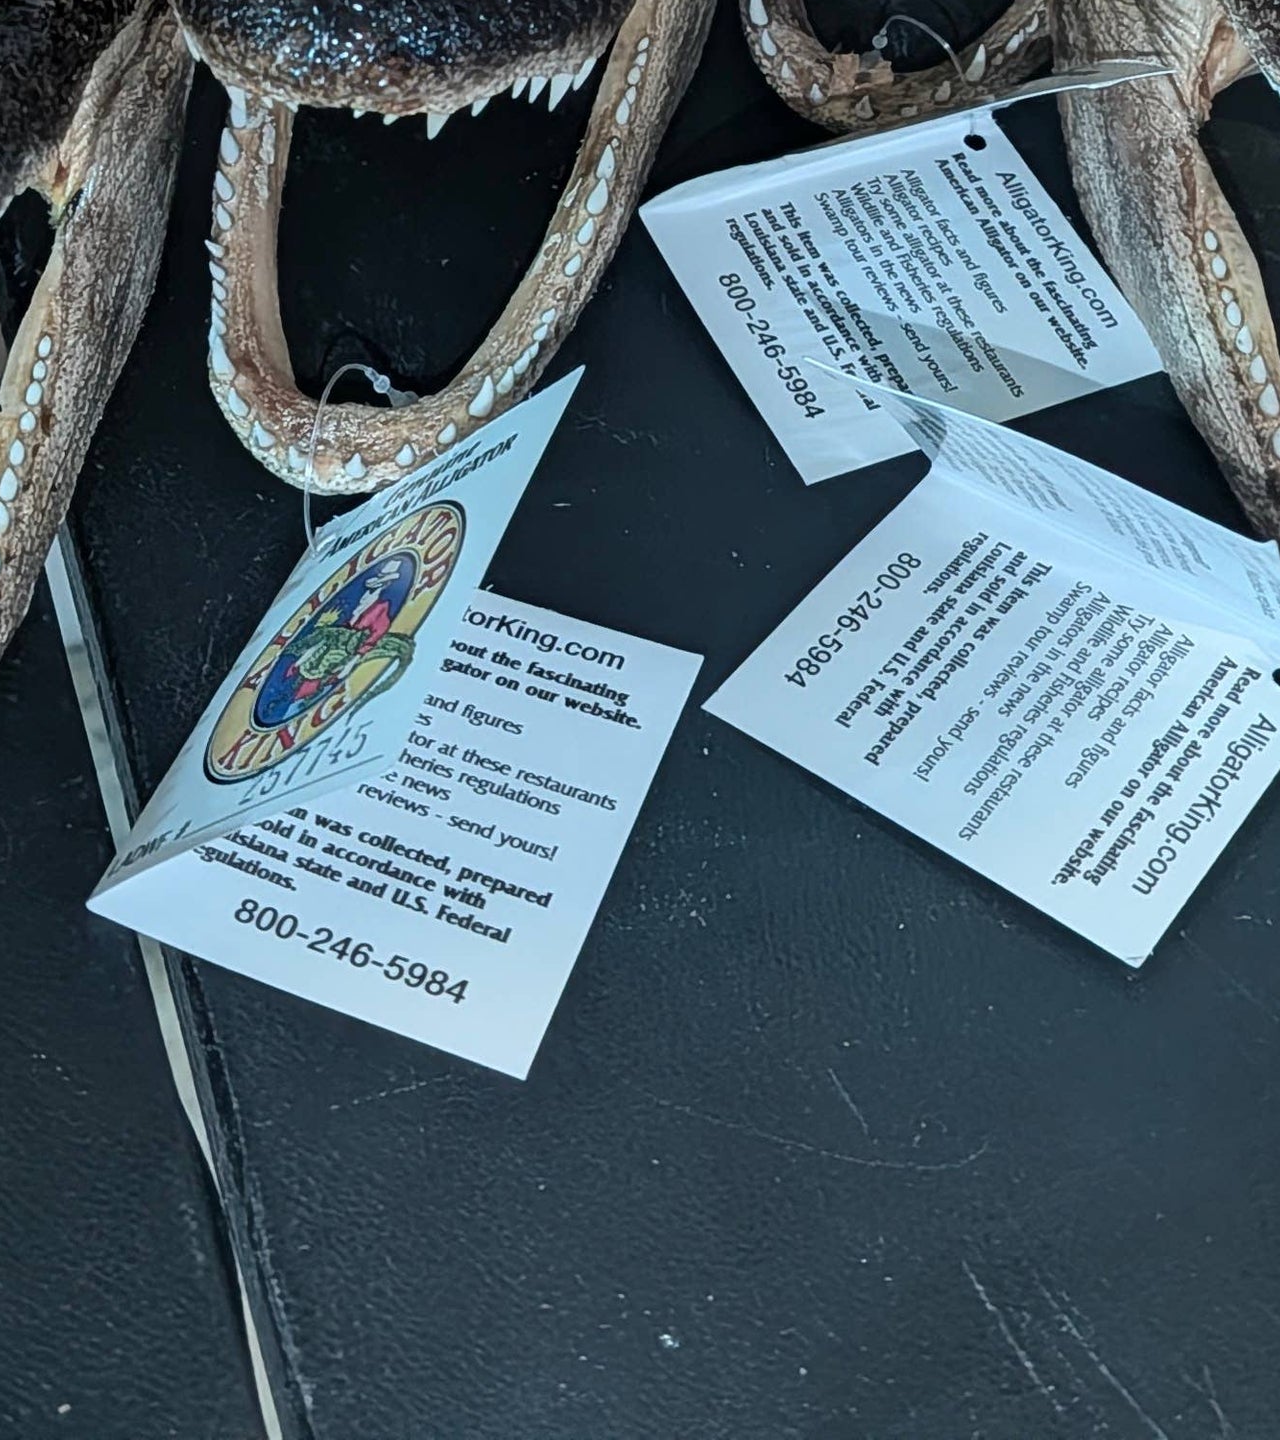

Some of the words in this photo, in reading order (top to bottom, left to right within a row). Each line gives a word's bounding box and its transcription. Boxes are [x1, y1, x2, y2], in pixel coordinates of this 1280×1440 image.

[882, 174, 924, 222] Alligator
[916, 223, 954, 267] recipes
[724, 217, 775, 291] regulations.
[950, 151, 983, 184] Read
[973, 185, 1002, 218] more
[997, 219, 1032, 256] about
[1024, 256, 1046, 279] the
[1041, 279, 1098, 350] fascinating
[994, 171, 1118, 328] AlligatorKing.com
[718, 272, 825, 419] 800-246-5984
[412, 433, 519, 508] ALLIGATOR
[922, 531, 989, 594] regulations.
[952, 541, 1012, 595] Louisiana
[1001, 550, 1028, 577] and
[1020, 561, 1053, 587] This
[240, 509, 458, 691] ALLIGATOR
[925, 594, 958, 625] state
[963, 600, 986, 616] in
[976, 573, 1007, 604] sold
[994, 586, 1029, 615] item
[1044, 580, 1092, 625] Swamp
[783, 551, 922, 688] 800-246-5984
[901, 625, 930, 654] and
[971, 615, 1001, 641] was
[1023, 624, 1054, 652] tour
[1056, 590, 1111, 648] Alligators
[1085, 603, 1134, 648] Wildlife
[1126, 613, 1156, 634] Try
[877, 651, 911, 676] U.S.
[900, 615, 968, 686] accordance
[915, 641, 975, 701] collected,
[982, 649, 1029, 698] reviews
[1025, 661, 1053, 683] the
[1043, 646, 1066, 661] in
[1065, 646, 1092, 675] and
[1099, 631, 1134, 668] some
[1123, 622, 1174, 677] Alligator
[1145, 633, 1195, 689] Alligator
[439, 657, 492, 681] gator
[494, 675, 520, 691] on
[524, 685, 560, 703] our
[564, 696, 641, 729] website.
[489, 650, 522, 670] the
[525, 660, 630, 707] fascinating
[833, 677, 886, 728] Federal
[872, 688, 906, 717] with
[997, 681, 1032, 717] news
[1022, 671, 1076, 725] Fisheries
[1059, 666, 1106, 718] alligator
[1086, 675, 1130, 721] recipes
[1120, 686, 1155, 718] facts
[1180, 654, 1238, 719] American
[1224, 666, 1262, 705] Read
[218, 684, 347, 770] KING
[422, 693, 460, 713] and
[460, 703, 524, 735] figures
[863, 699, 922, 766] prepared
[946, 705, 980, 742] send
[1046, 716, 1065, 733] at
[1098, 716, 1127, 746] and
[1196, 702, 1231, 739] more
[912, 734, 954, 782] yours!
[963, 723, 1028, 796] regulations
[1016, 731, 1055, 768] these
[1064, 742, 1110, 789] figures
[1136, 718, 1190, 779] Alligator
[1164, 739, 1202, 782] about
[397, 747, 455, 779] heries
[456, 771, 561, 815] regulations
[400, 775, 452, 801] news
[436, 742, 459, 758] at
[460, 748, 512, 776] these
[514, 768, 617, 811] restaurants
[1119, 778, 1141, 798] on
[1145, 780, 1174, 806] the
[355, 783, 430, 817] reviews
[446, 814, 496, 840] send
[494, 831, 559, 861] yours!
[957, 767, 1023, 841] restaurants
[1099, 799, 1124, 827] our
[1131, 712, 1277, 895] AlligatorKing.com
[296, 828, 318, 849] in
[320, 842, 437, 892] accordance
[443, 884, 486, 910] with
[314, 813, 353, 837] was
[357, 831, 451, 875] collected,
[455, 866, 553, 908] prepared
[1050, 827, 1105, 885] website.
[1082, 806, 1155, 886] fascinating
[291, 855, 342, 882] state
[345, 875, 389, 898] and
[390, 887, 429, 915] U.S.
[434, 903, 512, 943] Federal
[233, 898, 469, 1004] 800-246-5984
